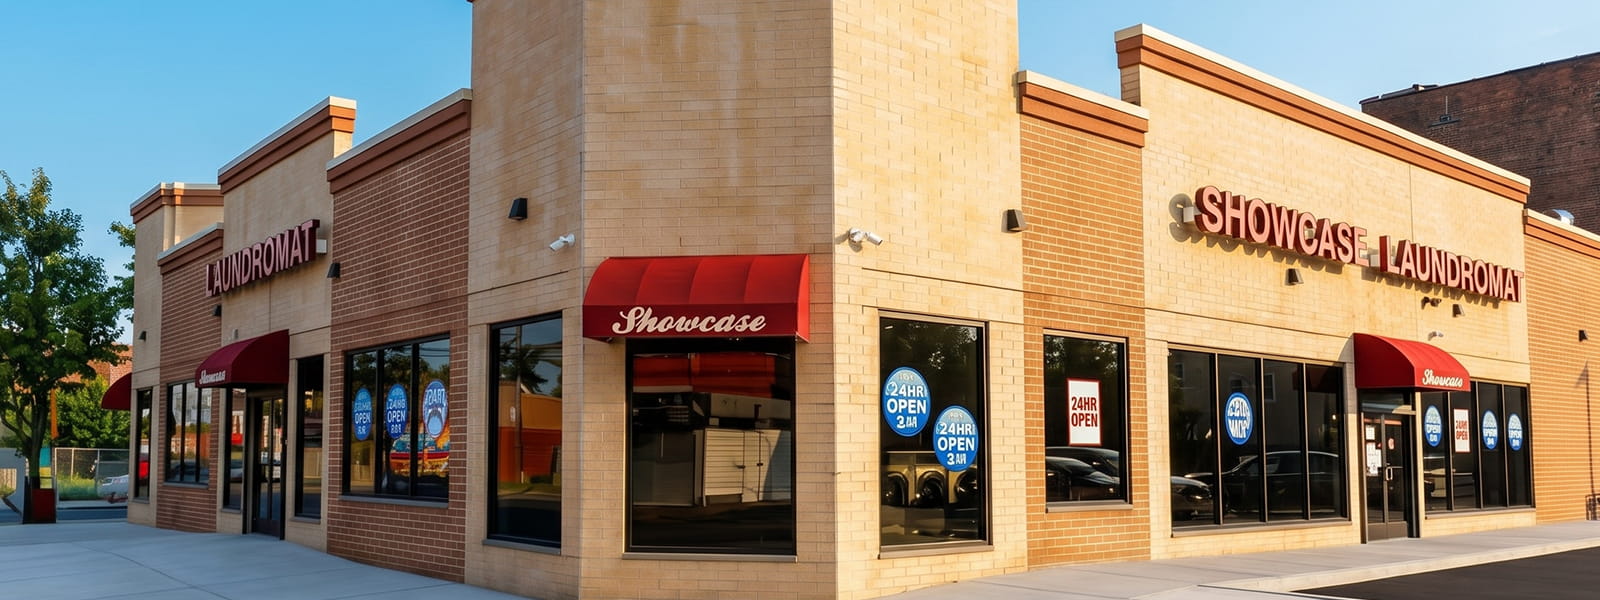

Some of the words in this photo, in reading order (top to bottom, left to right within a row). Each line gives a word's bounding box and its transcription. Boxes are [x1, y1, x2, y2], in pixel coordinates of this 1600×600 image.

[1197, 185, 1369, 267] SHOWCASE
[1381, 235, 1525, 303] LAUNDROMAT
[205, 219, 317, 297] LAUNDROMAT
[612, 306, 767, 334] Showcase
[886, 398, 927, 414] OPEN
[1071, 396, 1097, 411] 24HR
[354, 412, 371, 425] OPEN
[387, 410, 406, 423] OPEN
[1071, 412, 1098, 427] OPEN
[937, 436, 975, 451] OPEN
